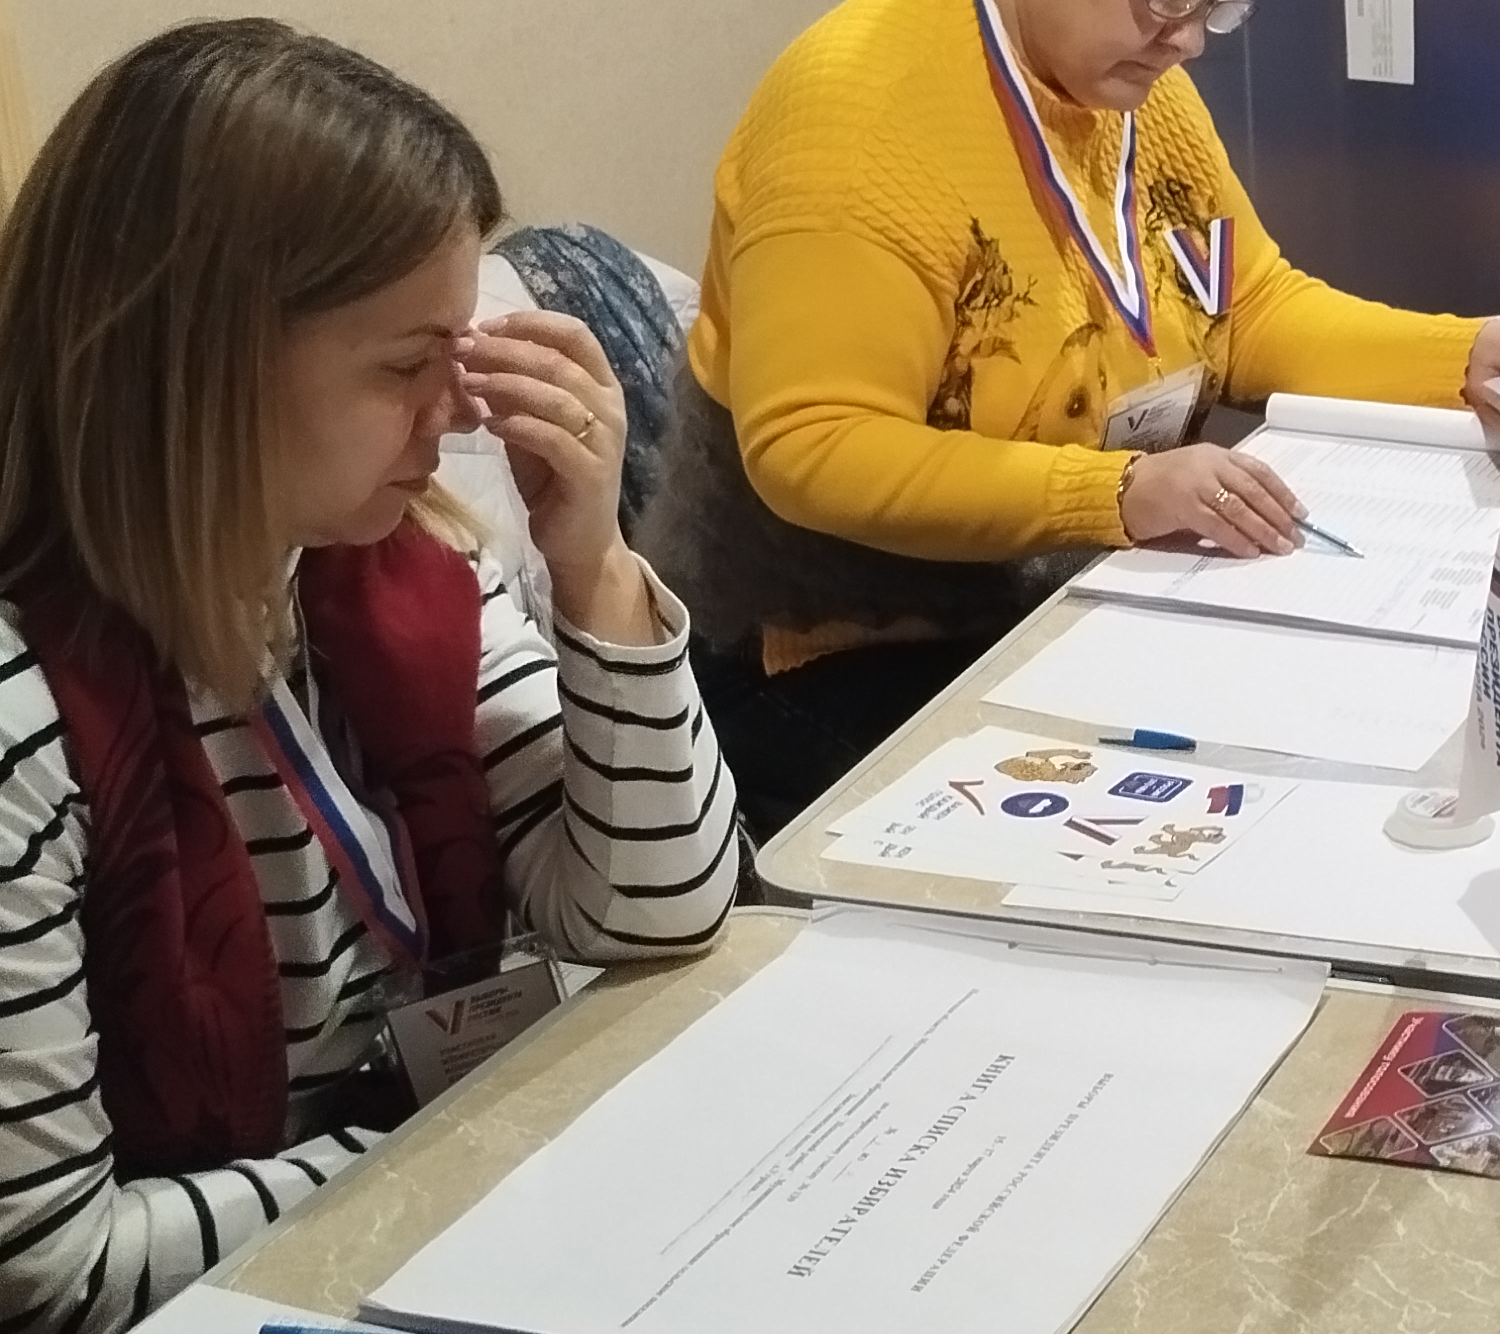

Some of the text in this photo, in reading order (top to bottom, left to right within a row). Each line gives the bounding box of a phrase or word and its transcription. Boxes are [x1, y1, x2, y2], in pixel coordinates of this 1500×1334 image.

[956, 1053, 1017, 1102] КНИГА
[1075, 1072, 1116, 1109] ВЫБОРЫ
[895, 1104, 970, 1164] СПИСКА
[1021, 1112, 1080, 1170] ПРЕЗИДЕНТА
[783, 1166, 909, 1278] ИЗБИРАТЕЛЕЙ
[963, 1170, 1030, 1233] РОССИЙСКОЙ
[908, 1233, 971, 1292] ФЕДЕРАЦИИ
